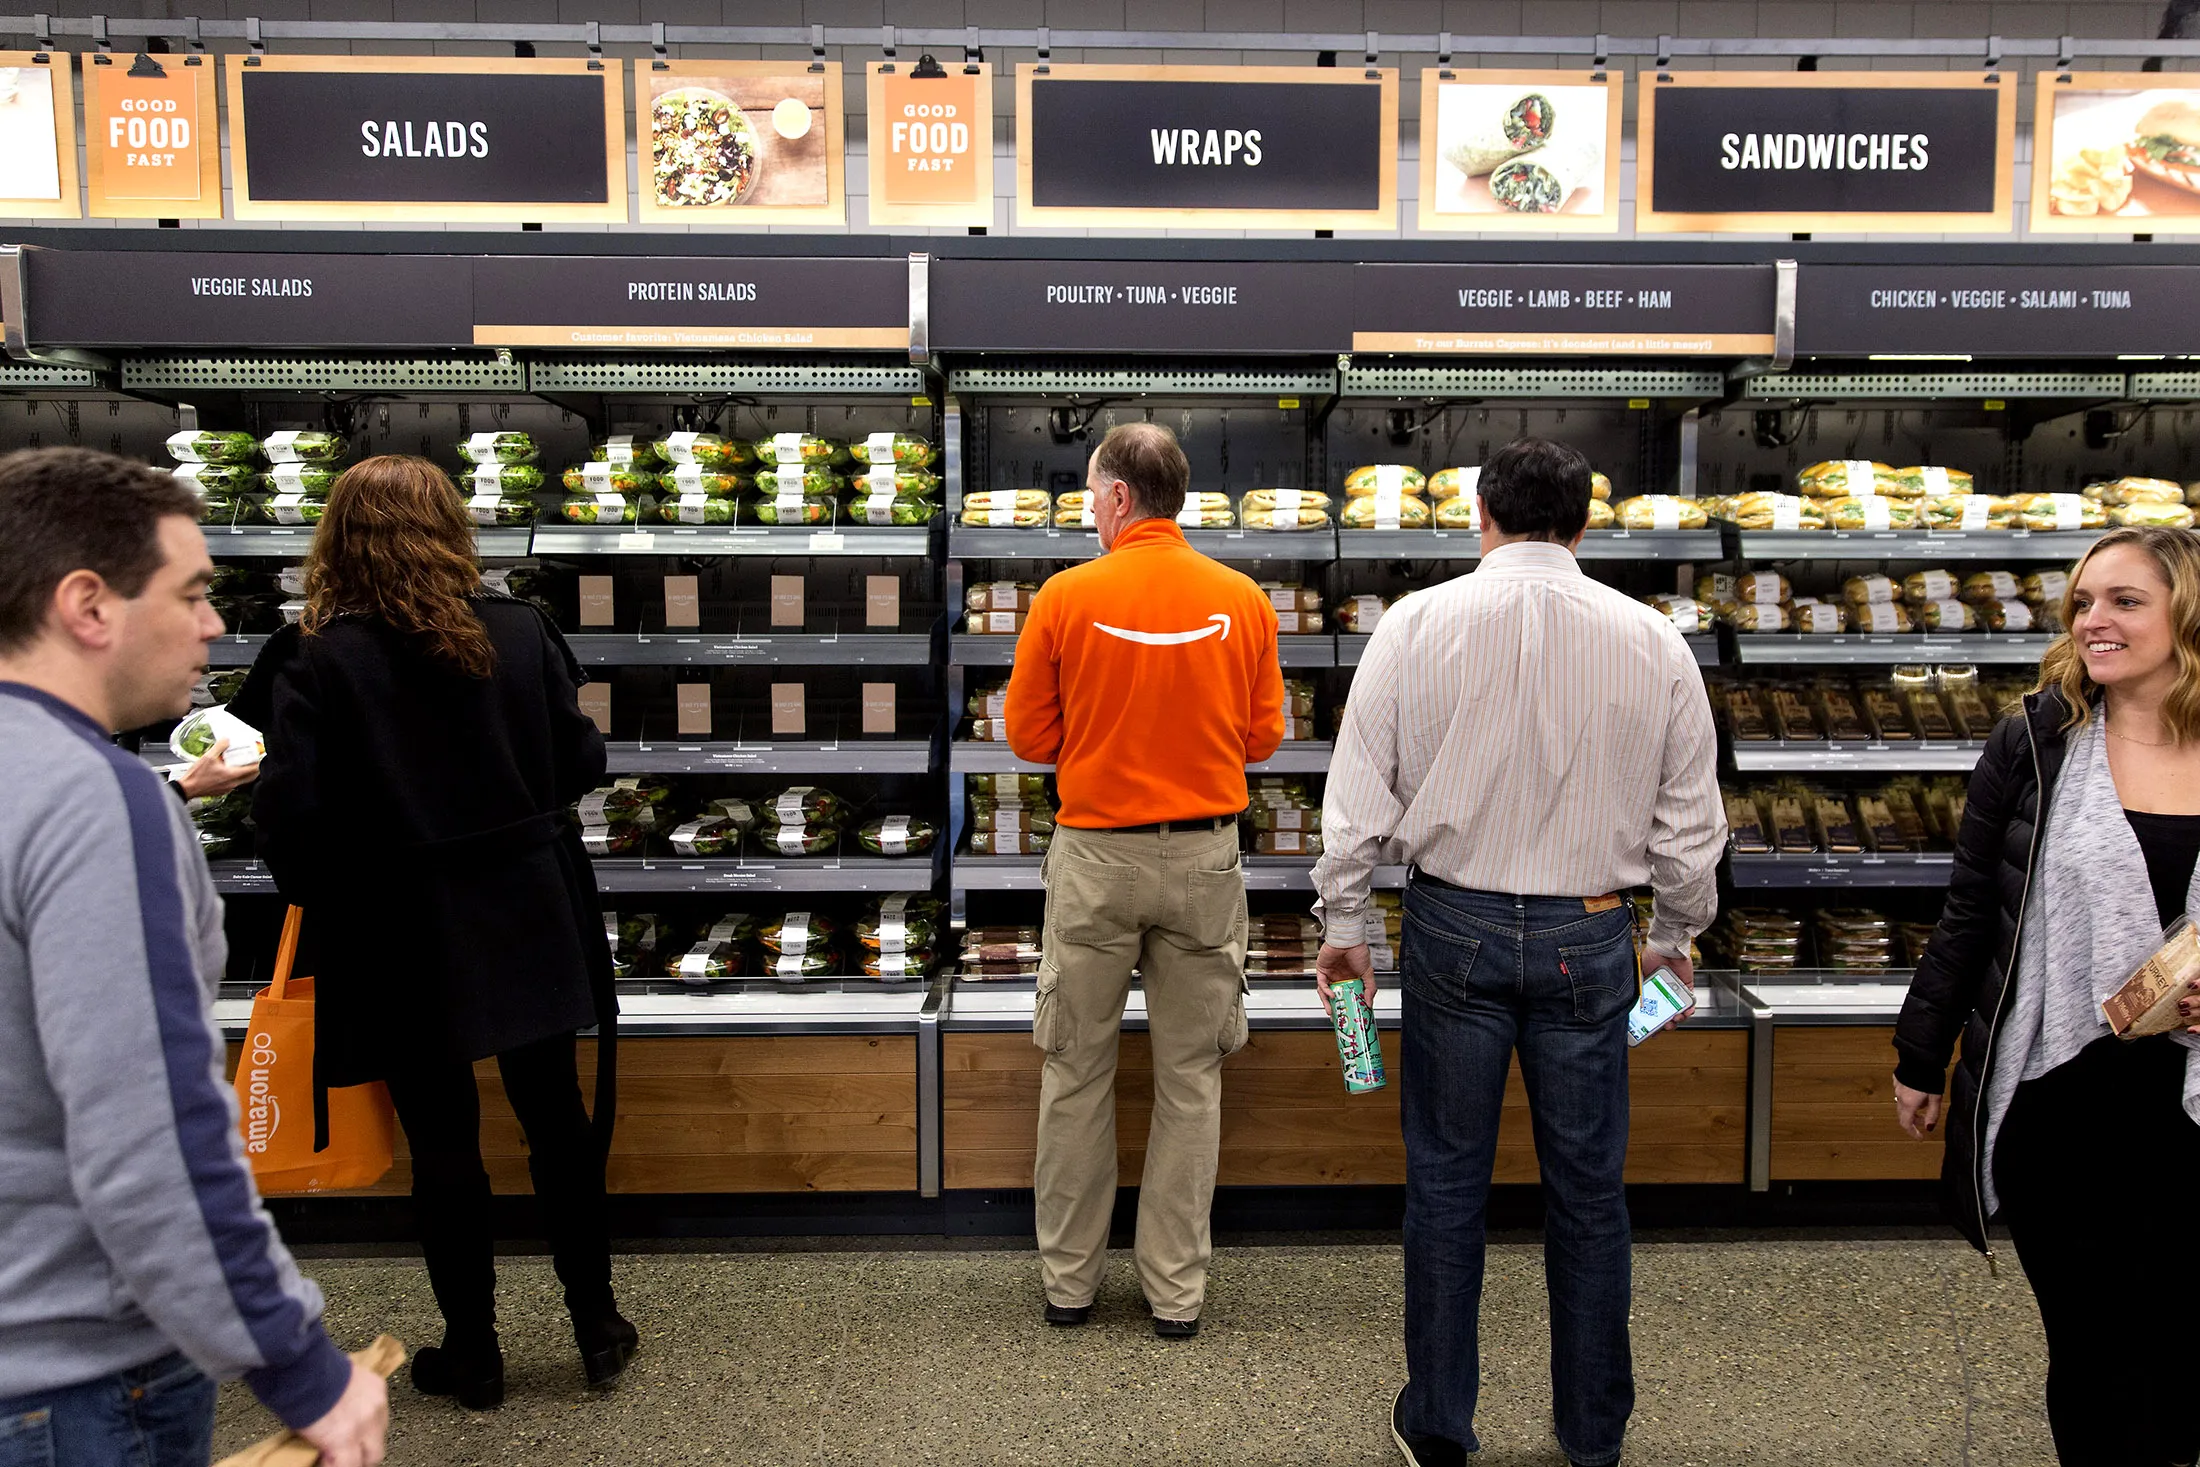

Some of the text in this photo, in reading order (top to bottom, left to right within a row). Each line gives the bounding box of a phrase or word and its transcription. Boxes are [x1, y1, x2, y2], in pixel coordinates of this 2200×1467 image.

[121, 98, 177, 113] GOOD
[903, 104, 957, 118] GOOD
[109, 117, 190, 149] FOOD
[361, 120, 489, 158] SALADS
[892, 121, 969, 154] FOOD
[1150, 128, 1262, 166] WRAPS
[1720, 133, 1930, 172] SANDWICHES
[126, 153, 176, 168] FAST
[907, 158, 954, 172] FAST
[191, 277, 313, 297] VEGGIE SALADS
[628, 282, 757, 301] PROTEIN SALADS
[1046, 285, 1237, 305] POULTRY TUNA VEGGIE
[1458, 289, 1672, 308] VEGGIE LAMB BEEF HAM
[1871, 289, 2132, 309] CHICKEN VEGGIE SALAMI TUNA
[571, 332, 813, 343] Customer favorite: Vietnamese Chicken Salad
[1416, 338, 1434, 350] Try
[1436, 340, 1454, 349] our
[1456, 338, 1494, 349] Burrata
[1543, 338, 1559, 349] it's
[1561, 339, 1609, 349] decadent
[1612, 339, 1636, 350] (and
[1646, 339, 1671, 349] little
[1673, 339, 1713, 351] messy!)
[2146, 959, 2170, 991] TURKEY
[248, 1032, 278, 1154] amazon go
